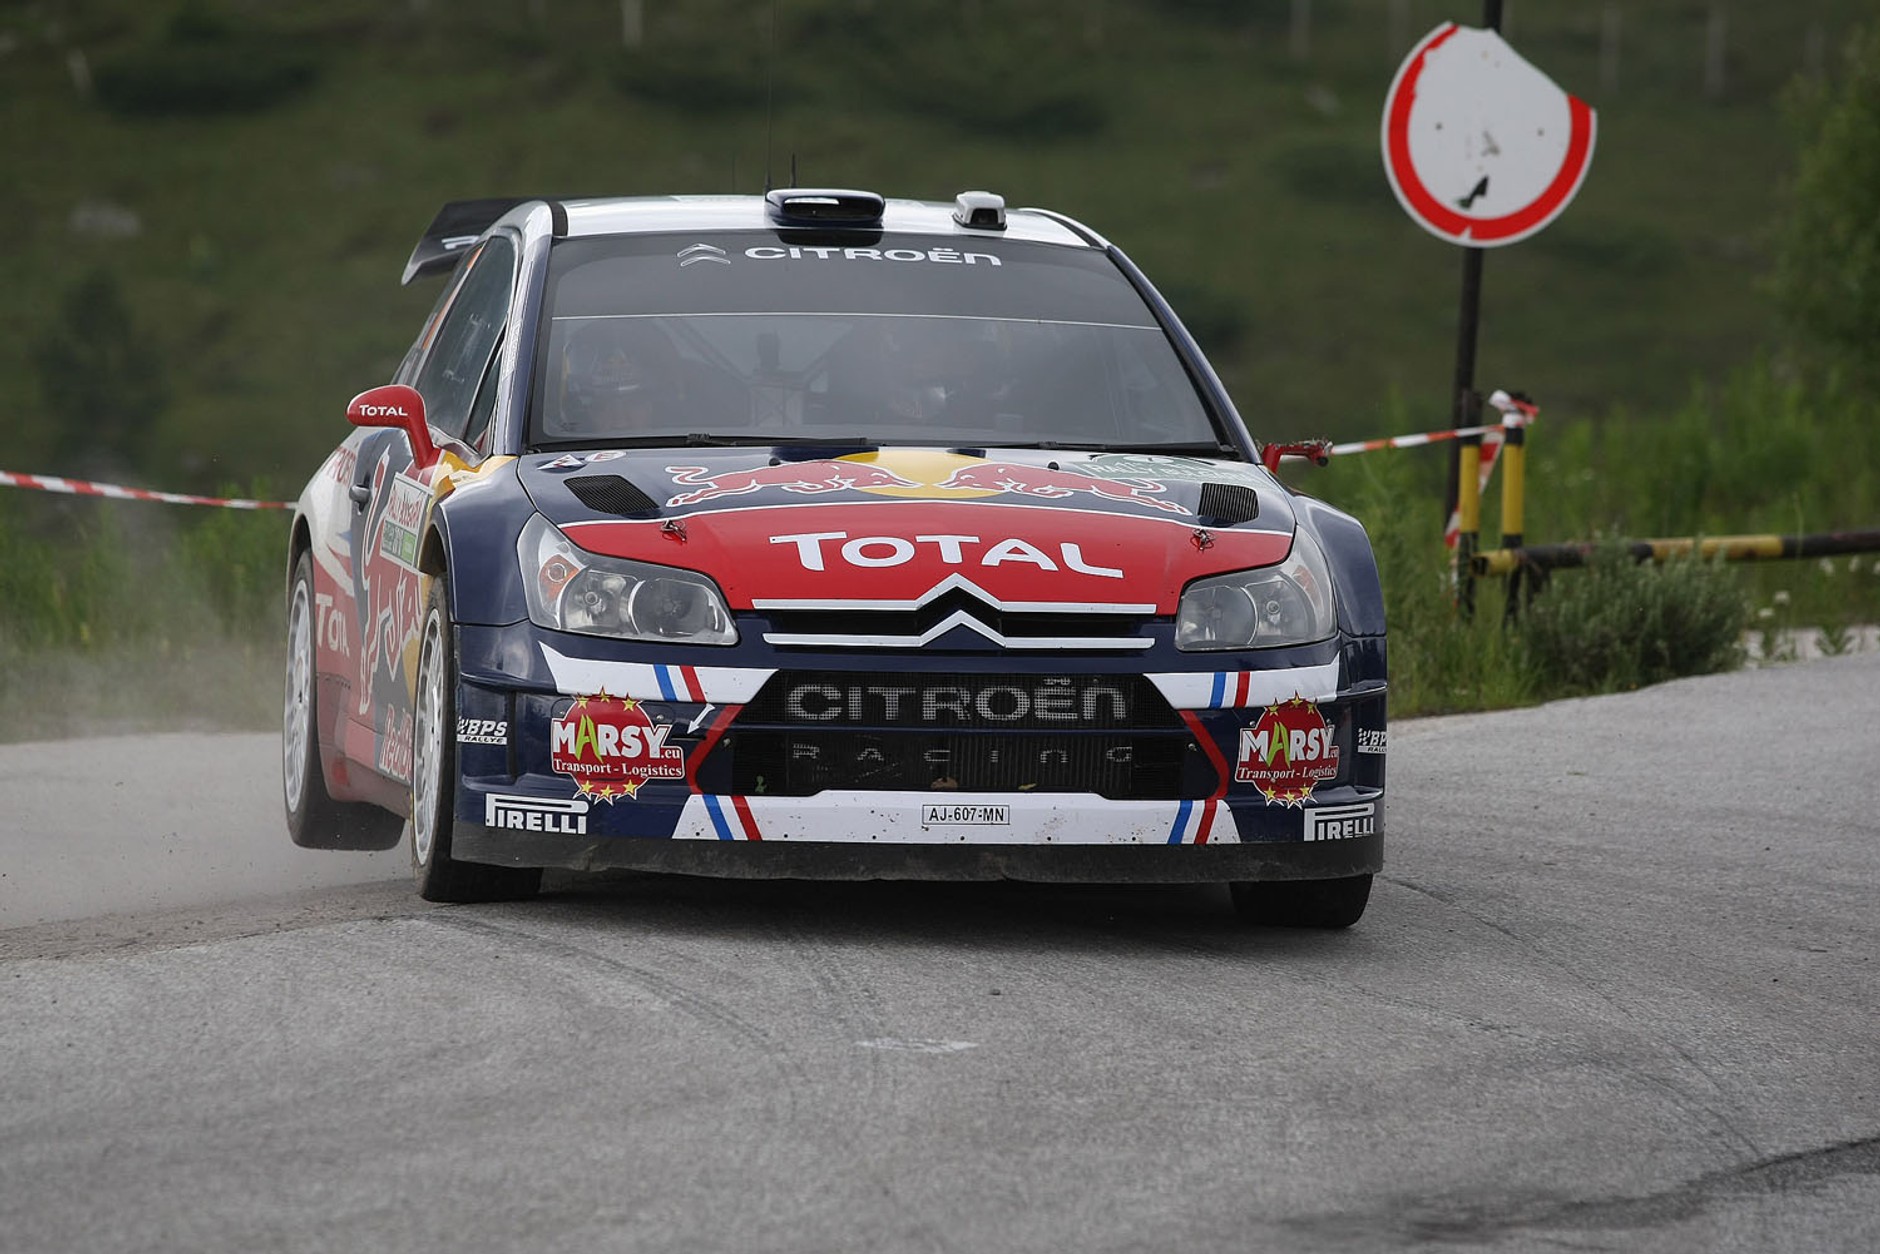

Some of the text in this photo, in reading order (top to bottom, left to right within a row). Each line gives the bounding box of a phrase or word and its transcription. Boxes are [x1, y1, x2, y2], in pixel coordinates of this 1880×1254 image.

[359, 404, 408, 417] TOTAL
[770, 531, 1123, 579] TOTAL
[467, 719, 508, 737] BPS
[554, 758, 612, 775] Transport
[622, 763, 682, 778] Logistics
[1238, 766, 1295, 782] Transport
[1302, 766, 1338, 781] Logistics
[485, 793, 589, 835] PIRELLI
[928, 807, 1004, 822] AJ-607-MN
[1303, 803, 1375, 842] PIRELLI
